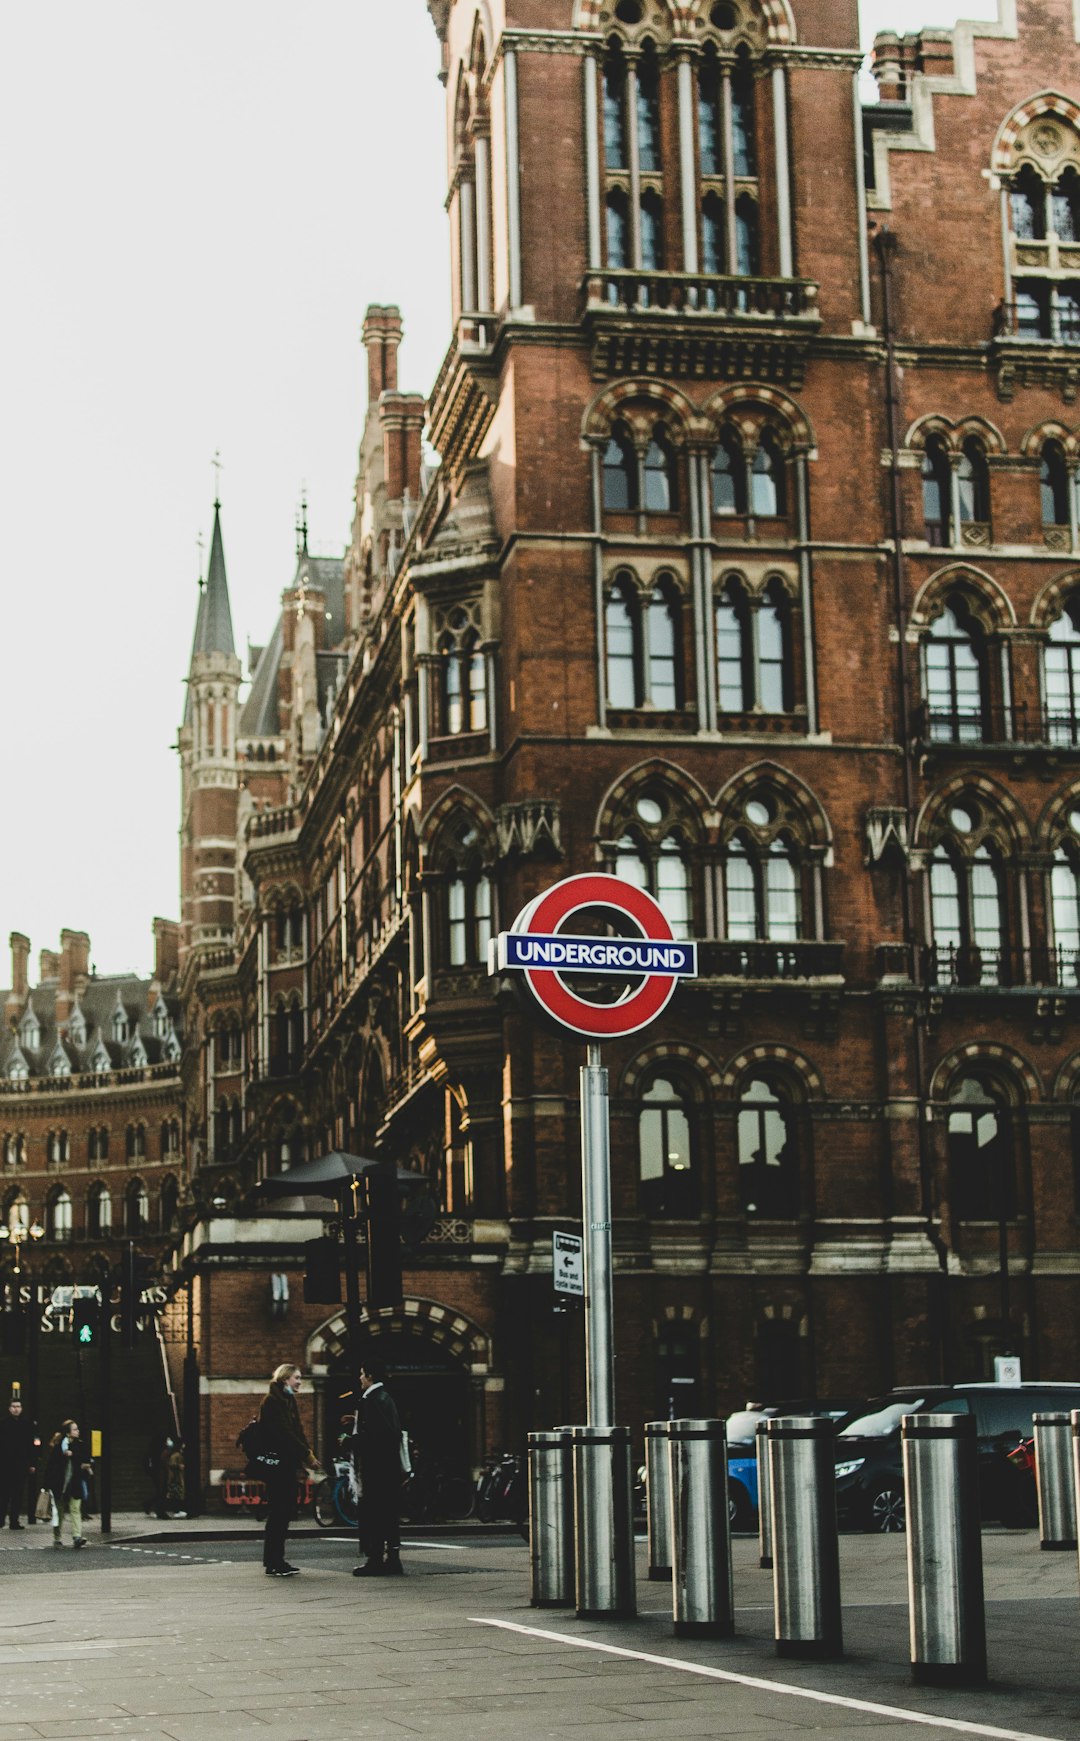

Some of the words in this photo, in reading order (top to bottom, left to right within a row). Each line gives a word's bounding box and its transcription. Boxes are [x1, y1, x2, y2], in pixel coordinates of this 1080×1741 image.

[515, 941, 686, 969] UNDERGROUND
[559, 1269, 568, 1278] Bus
[569, 1272, 579, 1281] and
